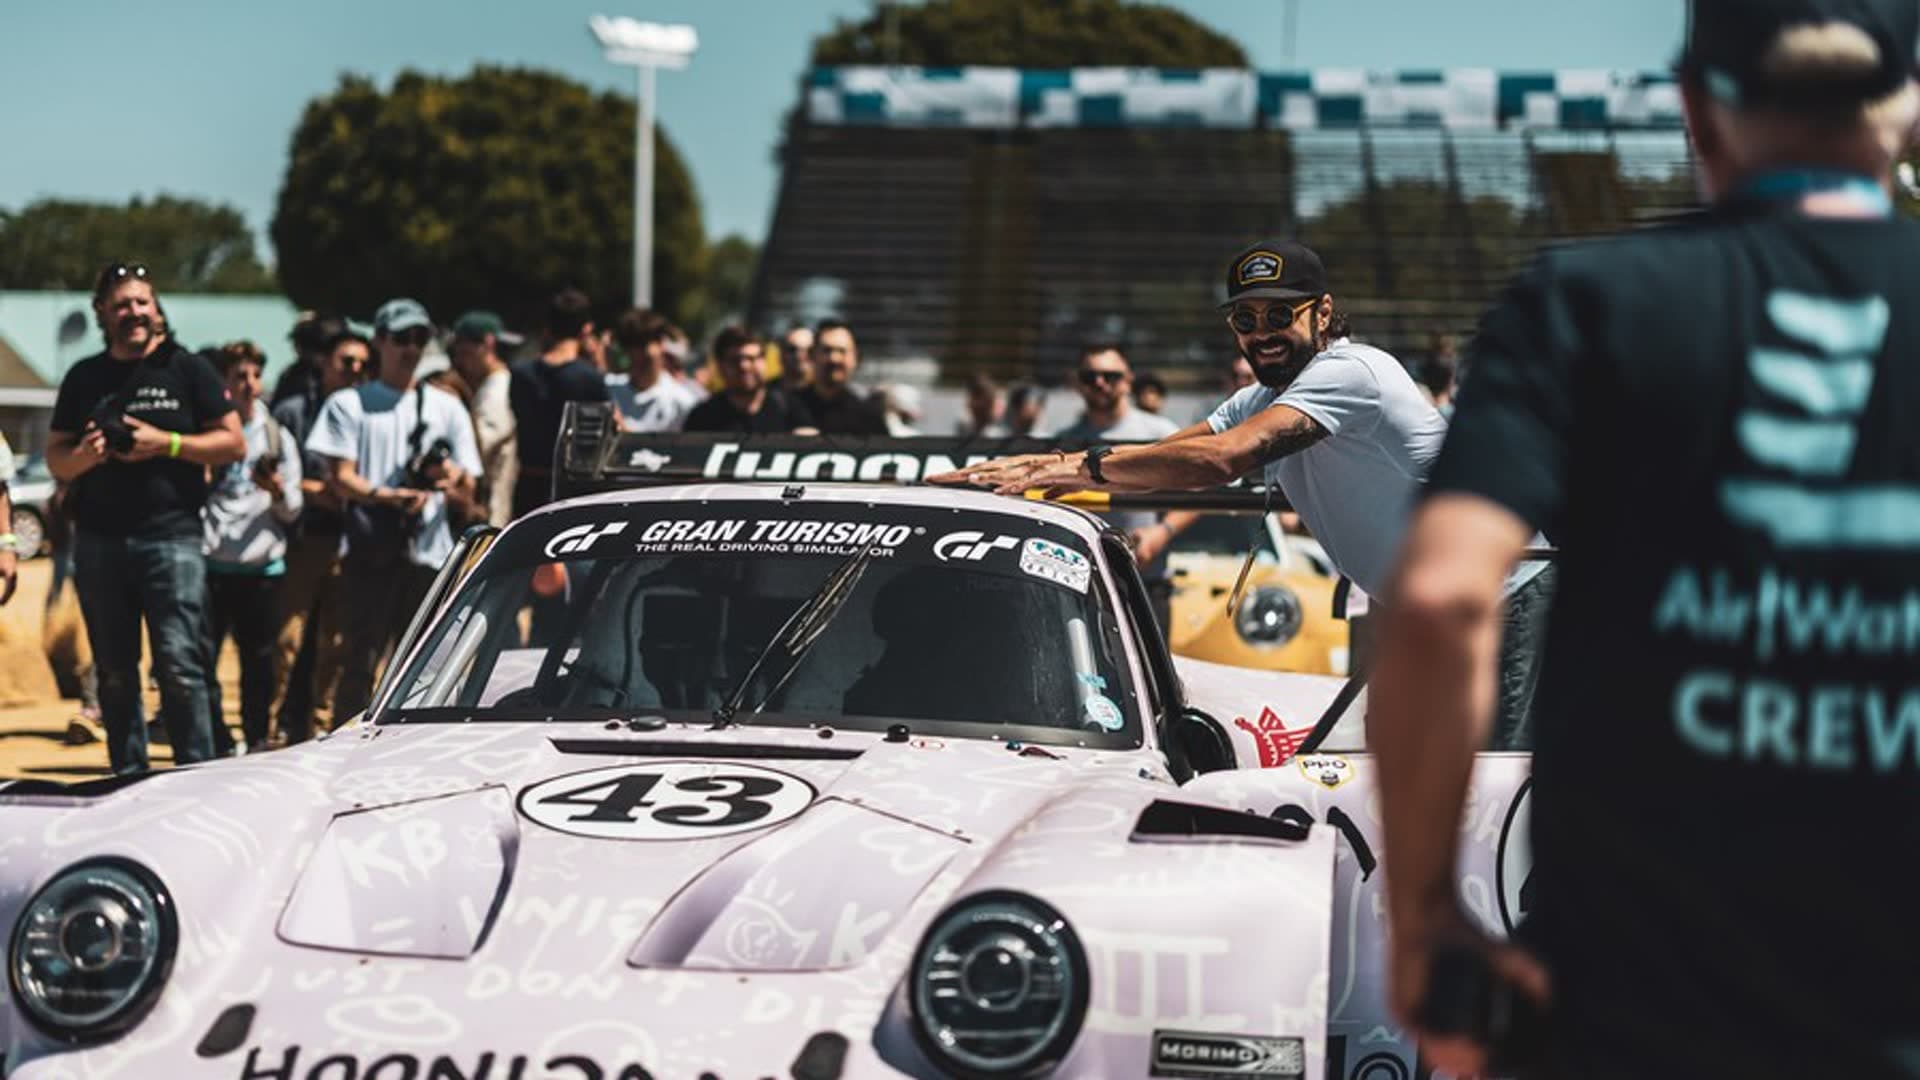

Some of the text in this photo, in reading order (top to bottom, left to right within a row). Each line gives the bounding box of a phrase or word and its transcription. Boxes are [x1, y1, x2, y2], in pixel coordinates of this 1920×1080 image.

[635, 542, 895, 558] THE REAL DRIVING SIMULAOR
[640, 519, 912, 547] GRAN TURISMO
[1670, 670, 1920, 770] CREW
[537, 773, 784, 828] 43
